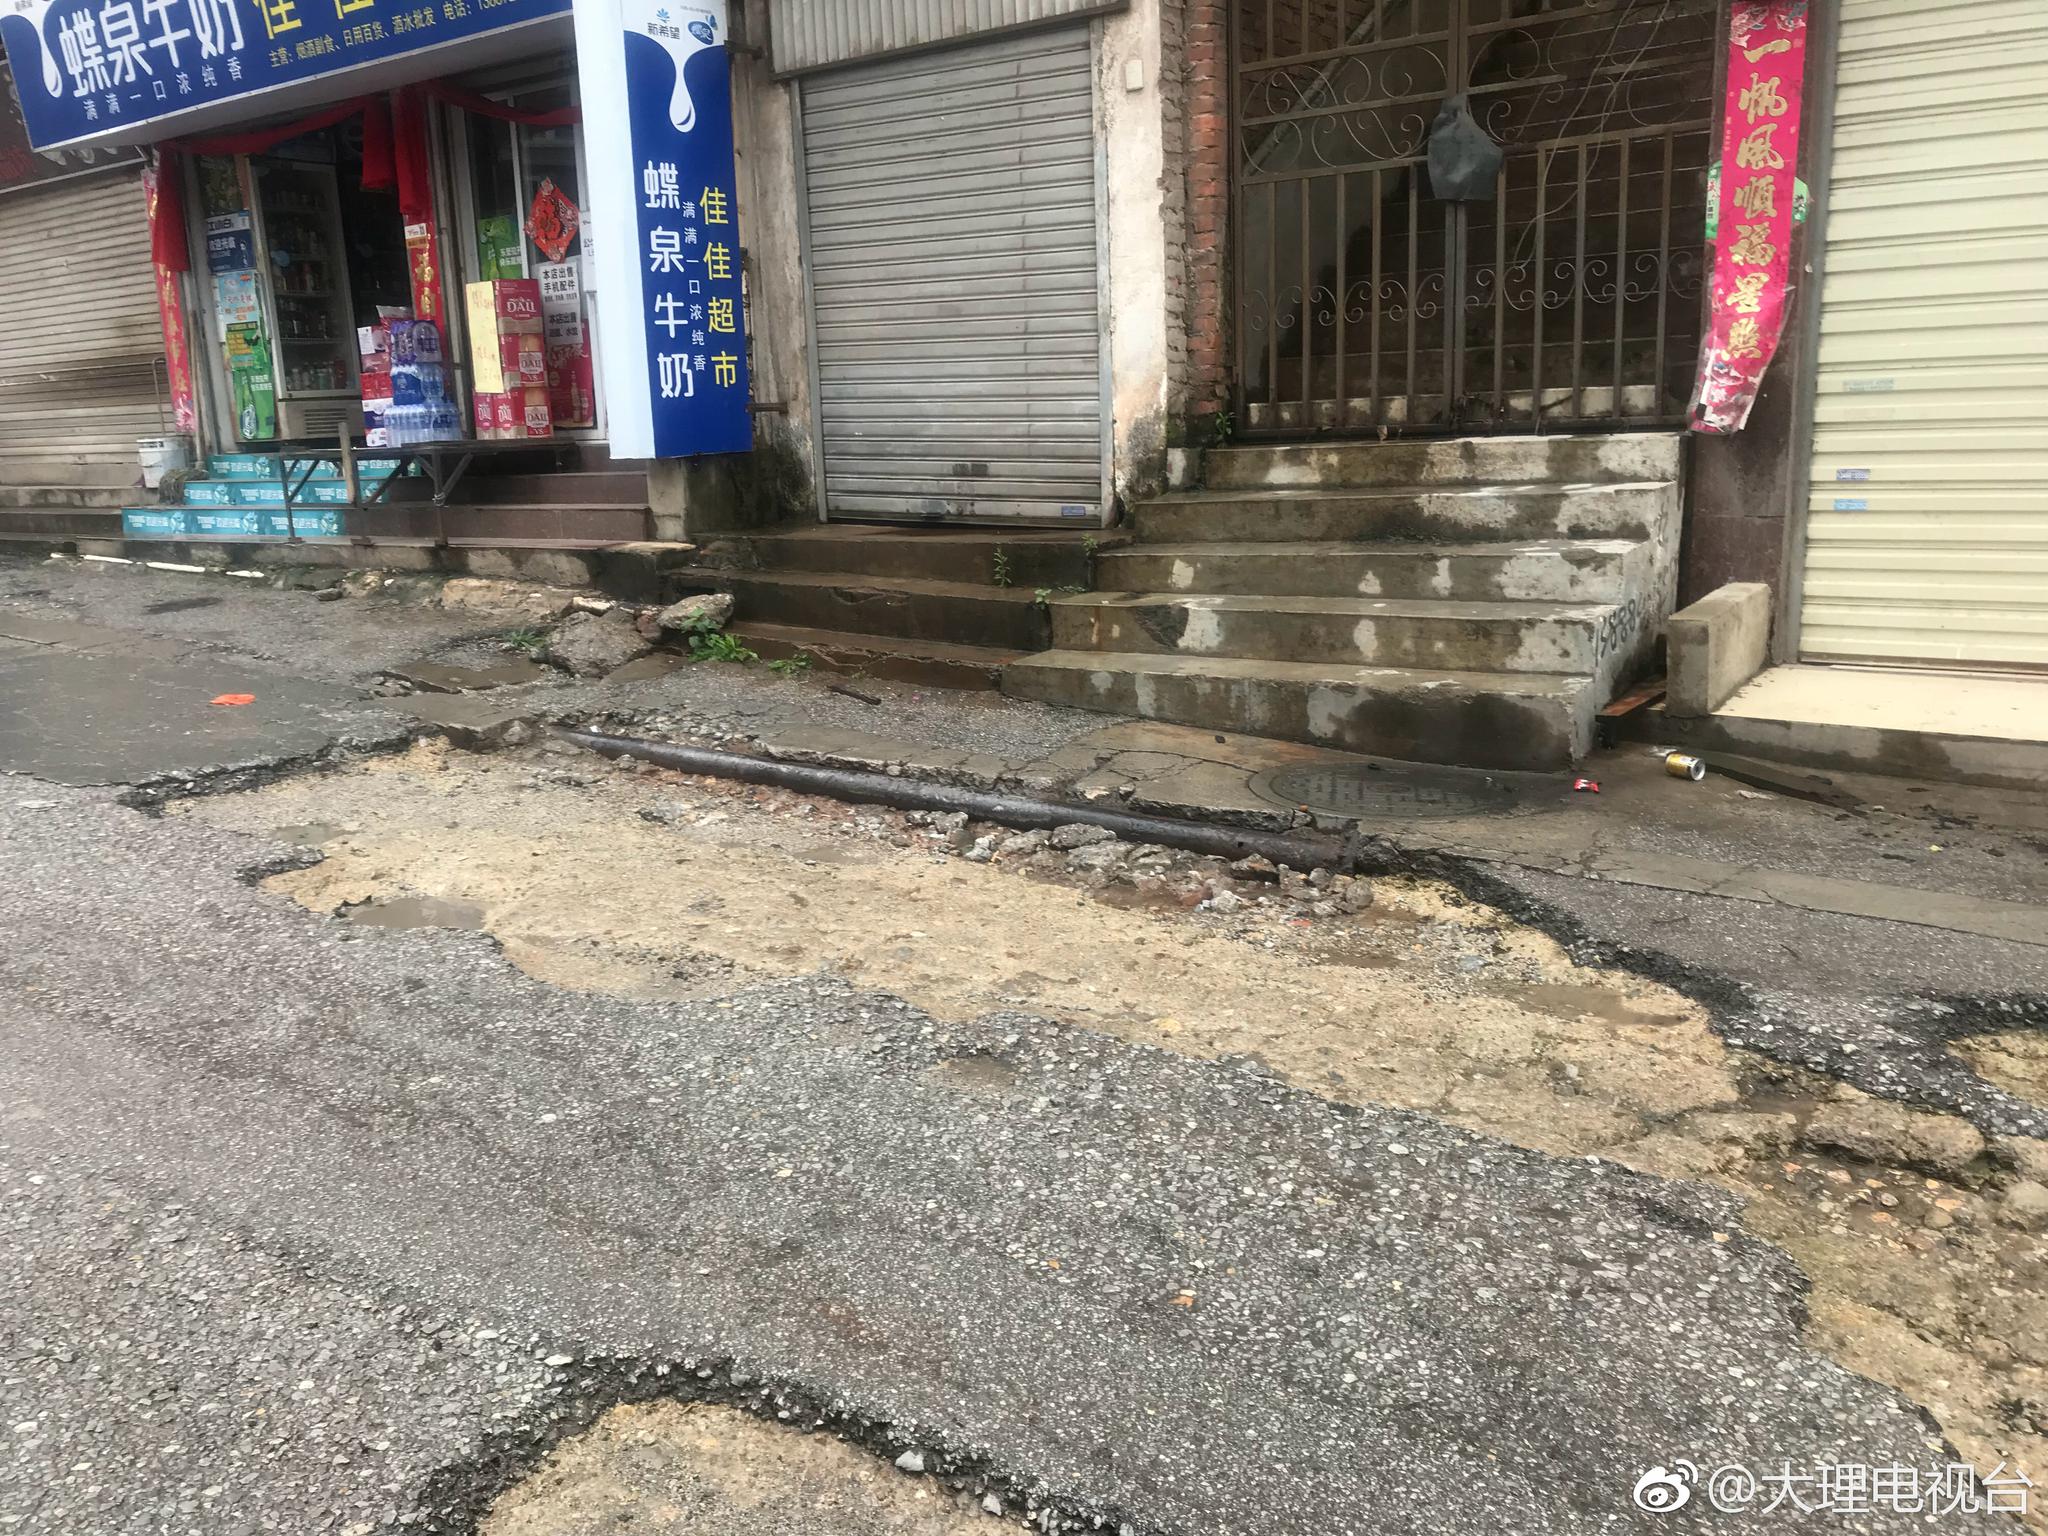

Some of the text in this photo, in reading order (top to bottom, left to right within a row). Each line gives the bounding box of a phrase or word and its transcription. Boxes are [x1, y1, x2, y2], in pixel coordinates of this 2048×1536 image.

[59, 0, 245, 98] 蝶泉牛奶
[647, 22, 680, 40] 新希望
[543, 266, 575, 281] 本店出售
[543, 280, 576, 294] 手机配件
[643, 160, 695, 399] 蝶泉牛奶
[682, 200, 706, 372] 满满一口浓纯香
[699, 186, 738, 388] 佳佳超市
